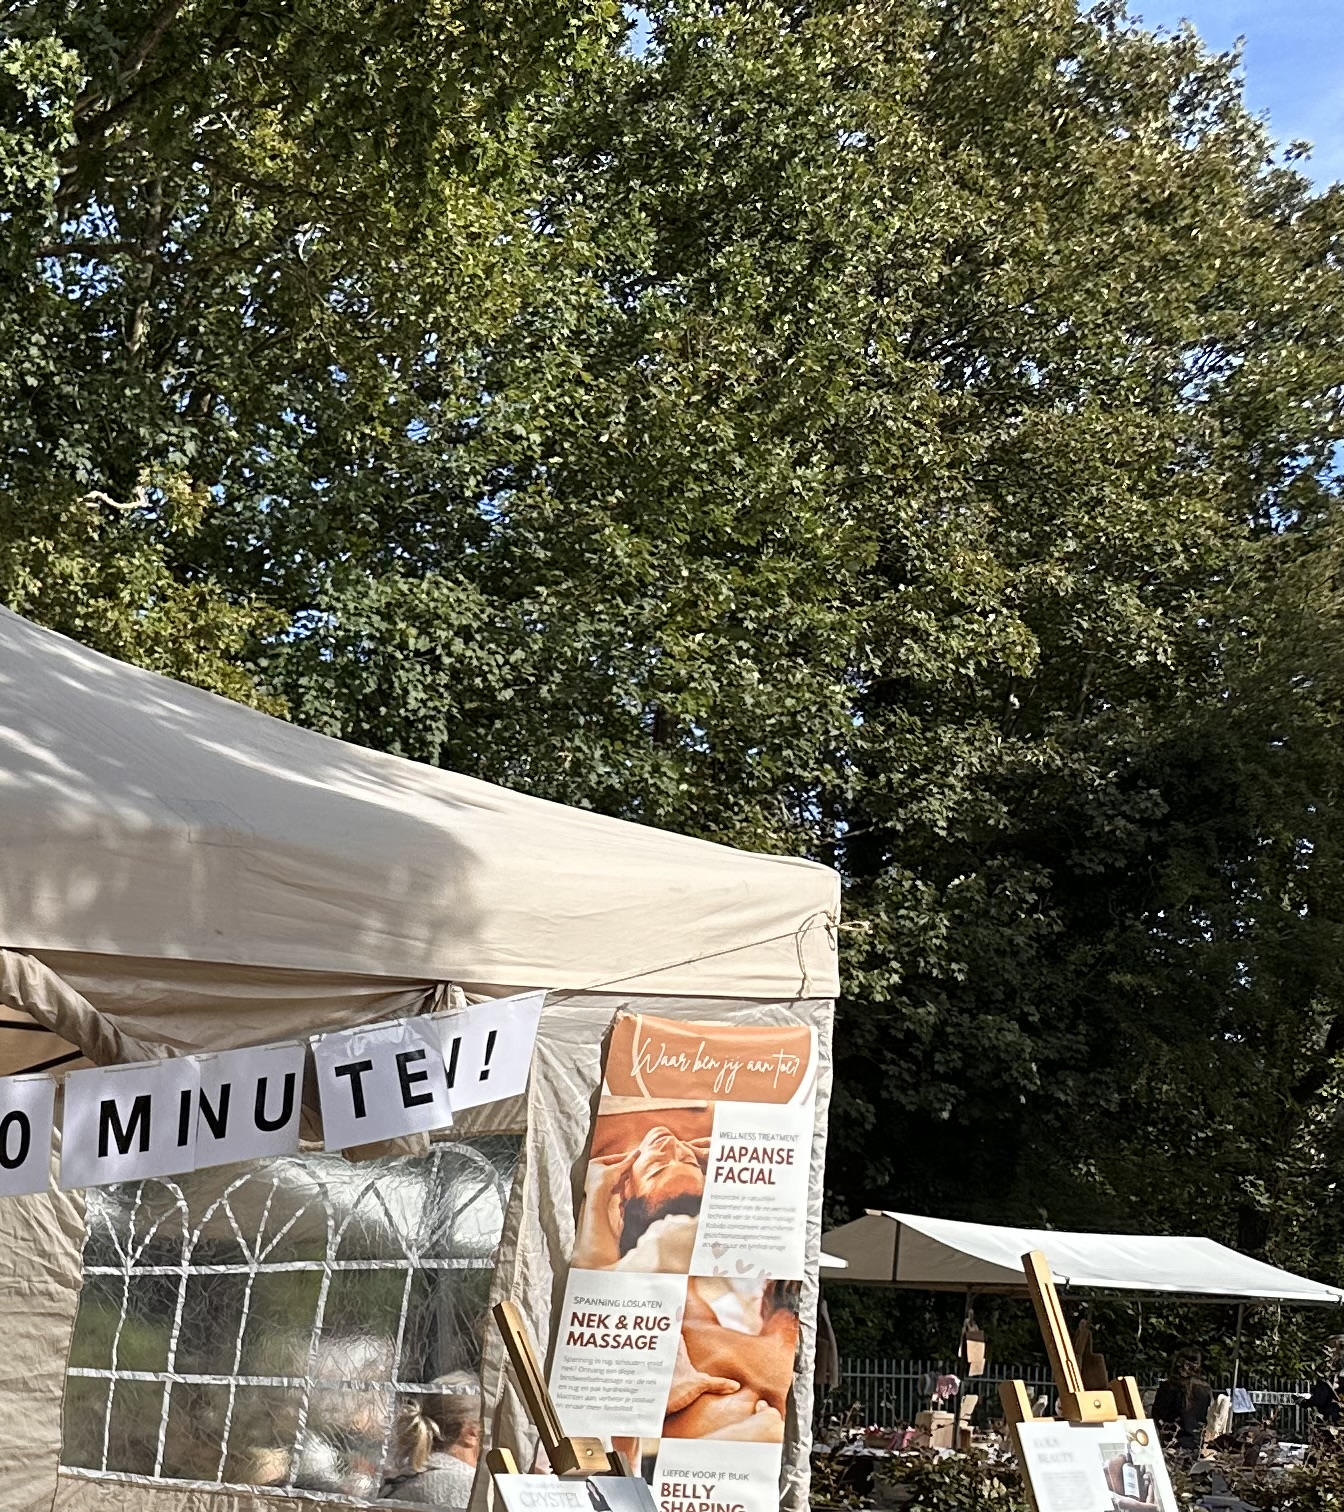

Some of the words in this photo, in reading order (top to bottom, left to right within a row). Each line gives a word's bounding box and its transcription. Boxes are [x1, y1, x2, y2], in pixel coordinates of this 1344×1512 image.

[631, 1038, 691, 1076] Waar
[692, 1041, 720, 1072] ben
[713, 1055, 744, 1093] jij
[747, 1061, 774, 1072] aan
[772, 1048, 800, 1089] toe?
[720, 1132, 756, 1141] WELLNESS
[758, 1132, 800, 1142] TREATMENT
[715, 1145, 794, 1165] JAPANSE
[713, 1166, 776, 1185] FACIAL
[573, 1296, 620, 1307] SPANNING
[622, 1300, 663, 1308] LOSLATEN
[570, 1311, 611, 1329] NEK
[615, 1315, 628, 1330] &
[633, 1315, 671, 1331] RUG
[566, 1331, 658, 1350] MASSAGE
[662, 1469, 690, 1478] LIEFDE
[692, 1471, 717, 1479] VOOR
[718, 1472, 726, 1481] JE
[729, 1473, 749, 1481] BUIK
[660, 1482, 715, 1499] BELLY
